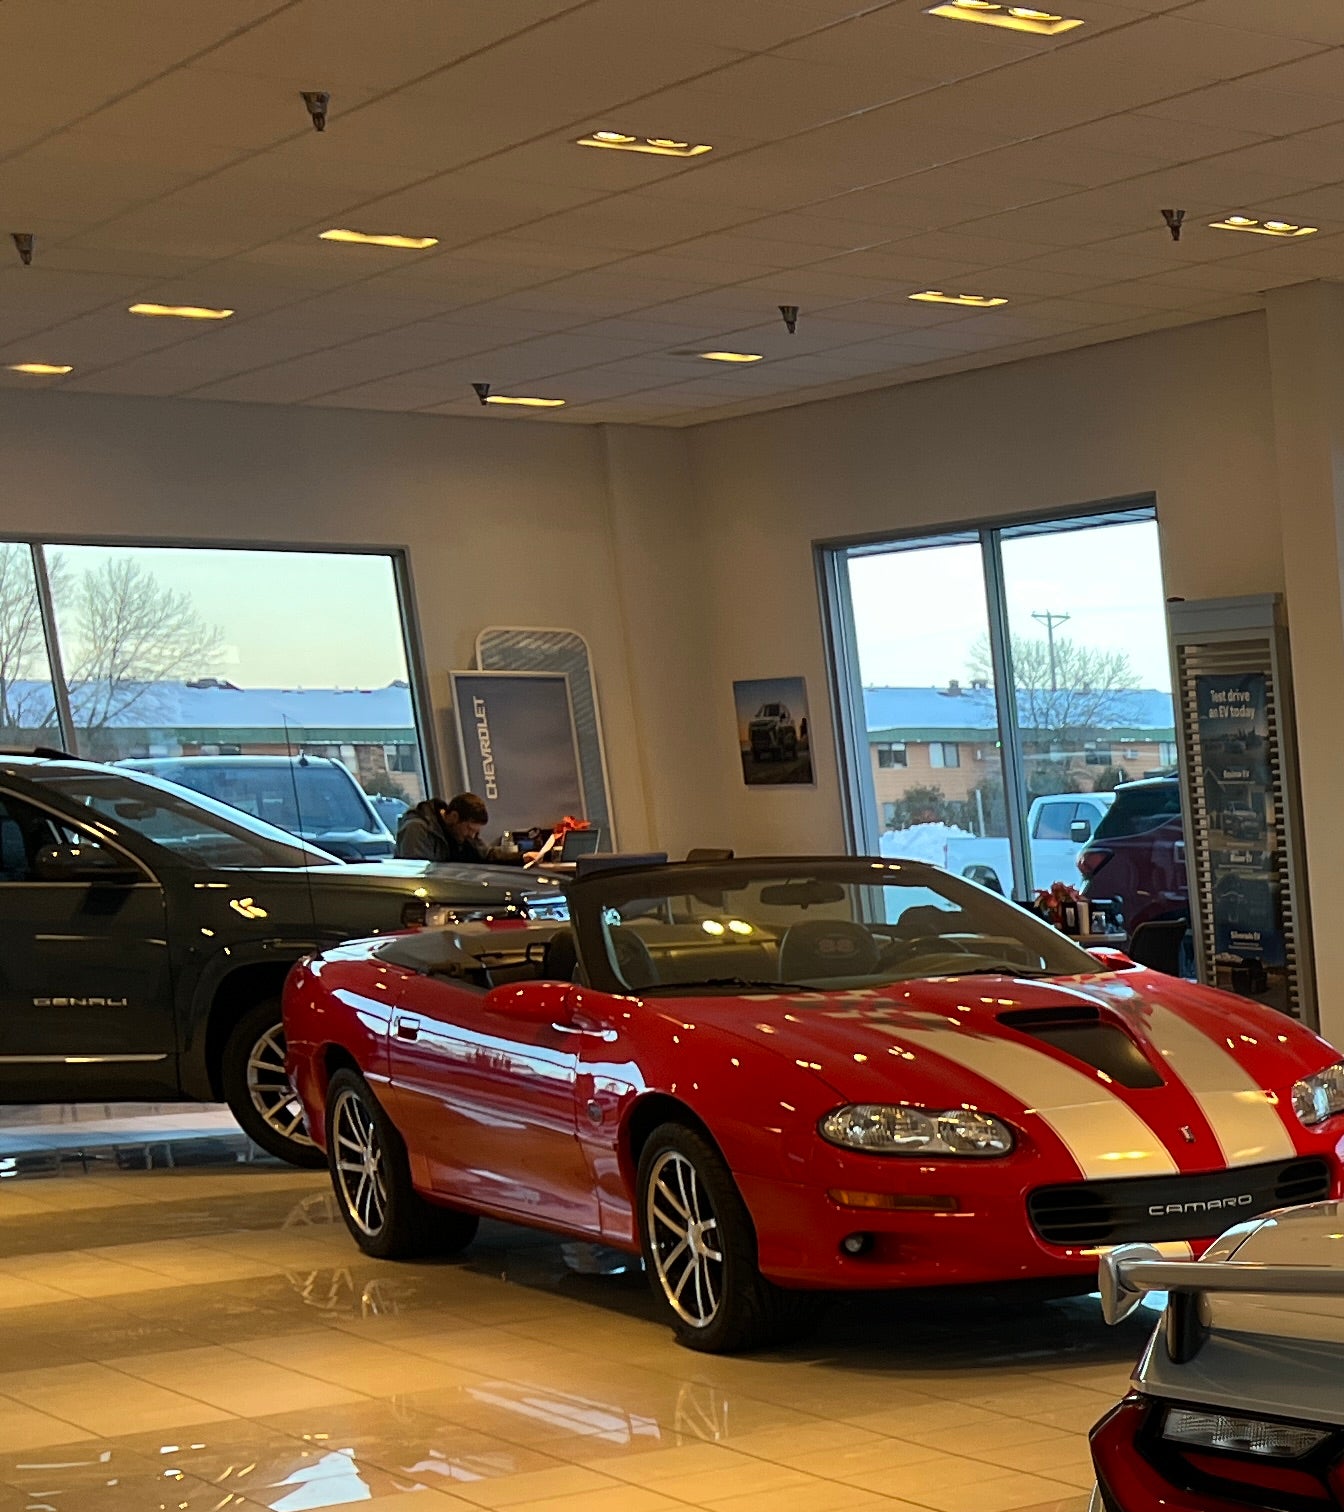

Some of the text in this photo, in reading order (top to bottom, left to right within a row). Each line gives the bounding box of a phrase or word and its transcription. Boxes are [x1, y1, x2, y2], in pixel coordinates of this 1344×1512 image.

[1210, 688, 1250, 702] Test drive
[1219, 705, 1229, 718] EV
[1230, 704, 1255, 720] today
[473, 696, 498, 799] CHEVROLET
[33, 997, 127, 1006] DENALI
[1149, 1194, 1253, 1216] CAMARO
